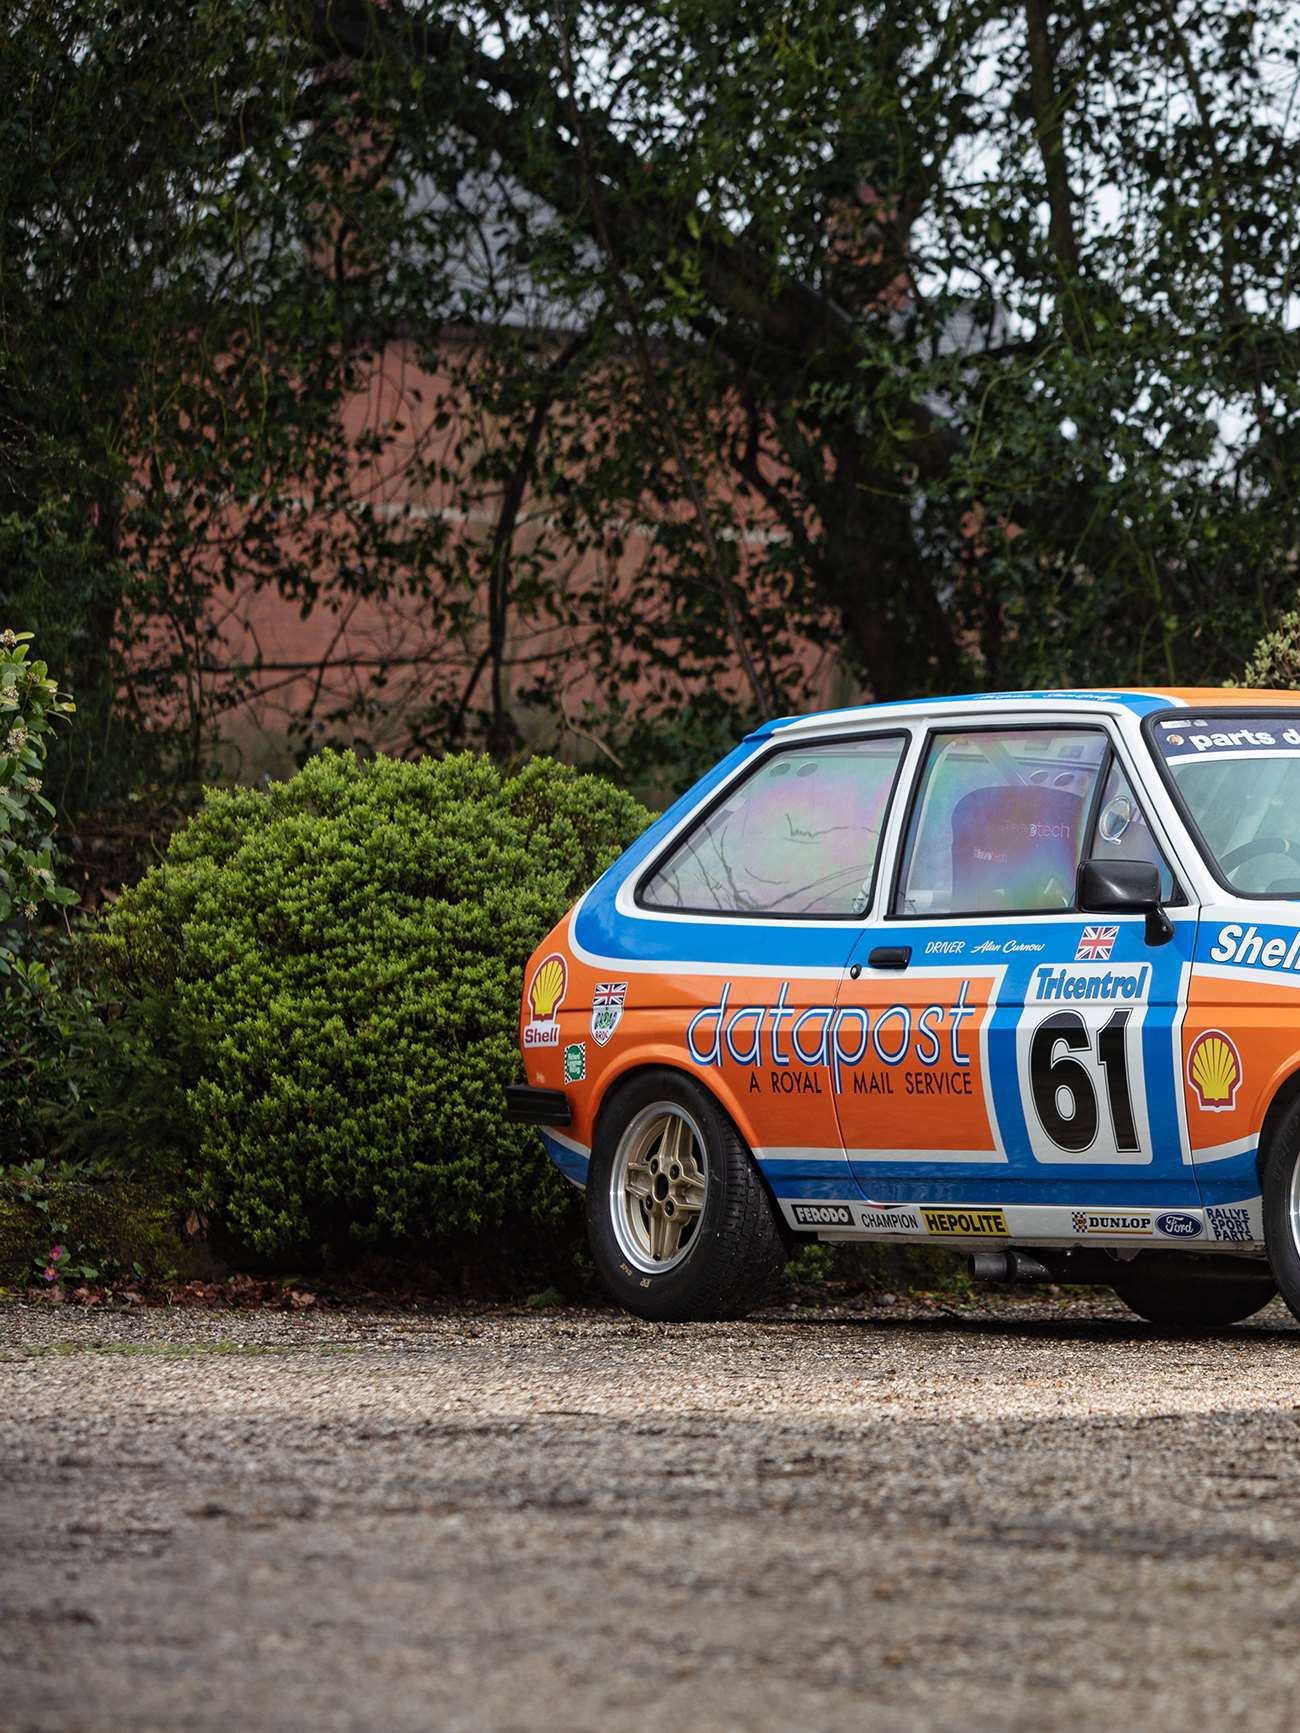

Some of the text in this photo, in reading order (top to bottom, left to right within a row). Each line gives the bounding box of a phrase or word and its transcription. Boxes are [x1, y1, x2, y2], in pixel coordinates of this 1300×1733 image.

[1188, 729, 1277, 751] parts
[925, 940, 1046, 954] DRIVER Alan Curnow
[1035, 965, 1148, 1000] Tricentrol
[525, 1027, 558, 1044] Shell
[687, 980, 976, 1094] datapost
[749, 1072, 973, 1095] A ROYAL MAIL SERVICE
[1029, 1007, 1142, 1153] 61
[798, 1206, 850, 1225] FERODO
[861, 1213, 918, 1229] CHAMPION
[925, 1213, 1006, 1233] HEPOLITE
[1088, 1217, 1150, 1229] DUNLOP
[1206, 1207, 1250, 1221] RALLYE
[1165, 1215, 1194, 1234] Ford
[1212, 1219, 1250, 1232] SPORT
[1215, 1230, 1253, 1241] PARTS
